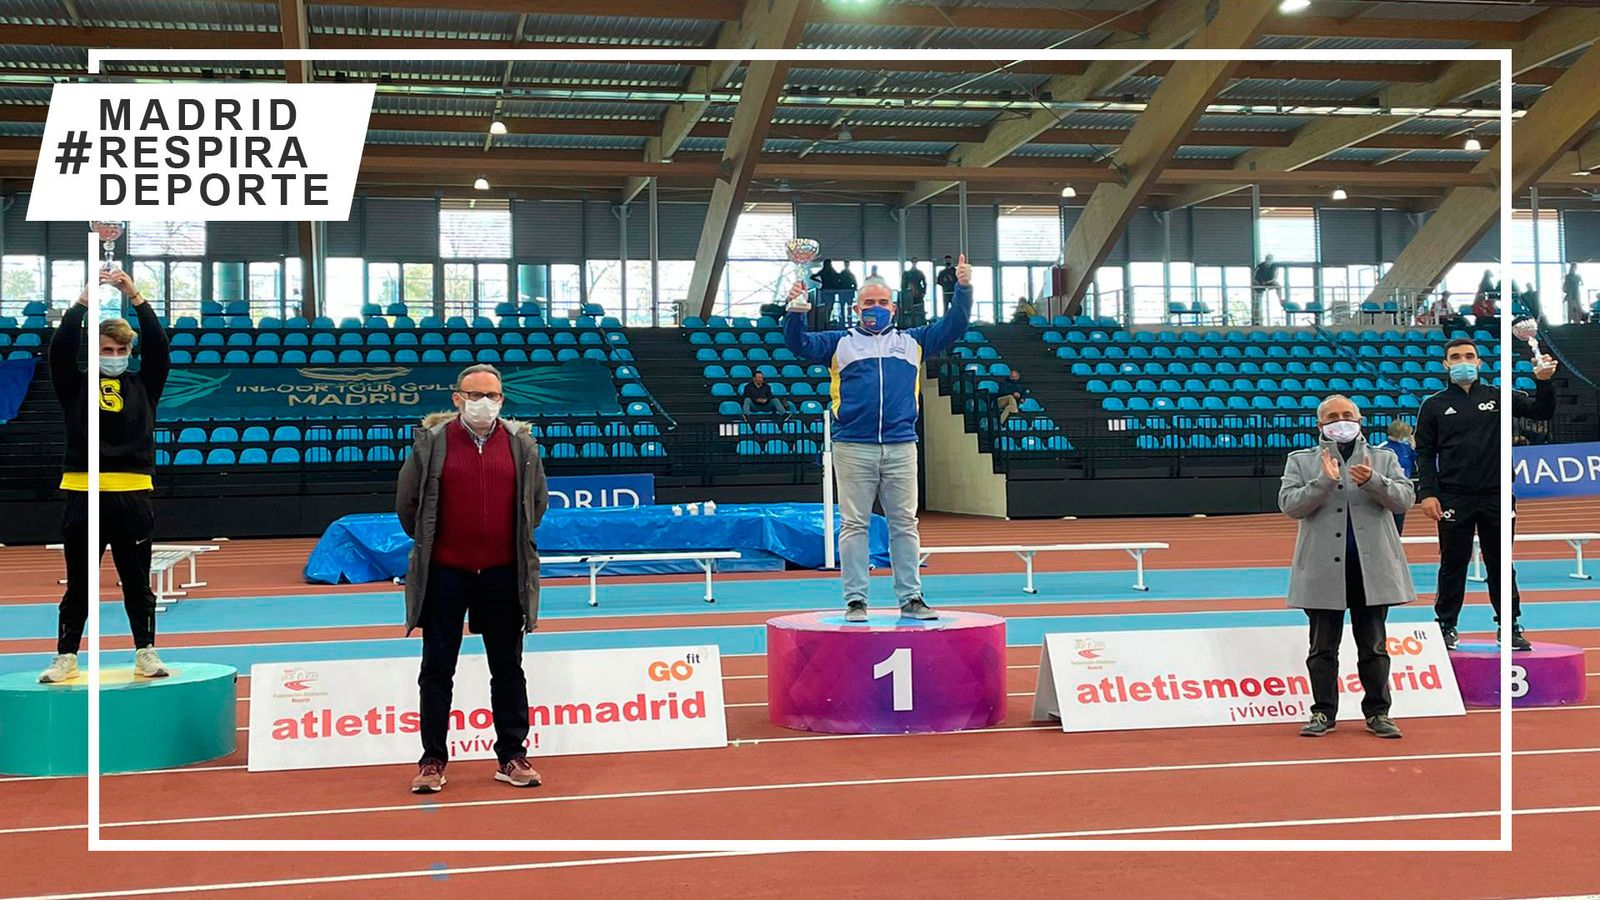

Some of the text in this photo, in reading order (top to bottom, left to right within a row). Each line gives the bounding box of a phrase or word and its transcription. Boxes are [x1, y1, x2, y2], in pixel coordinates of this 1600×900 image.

[287, 392, 420, 406] MADRID
[1385, 636, 1423, 656] GO
[686, 653, 701, 664] fit
[648, 659, 694, 682] GO
[873, 647, 913, 711] 1
[1076, 664, 1443, 704] atletismoenarid
[271, 690, 707, 741] atletisonmadrid
